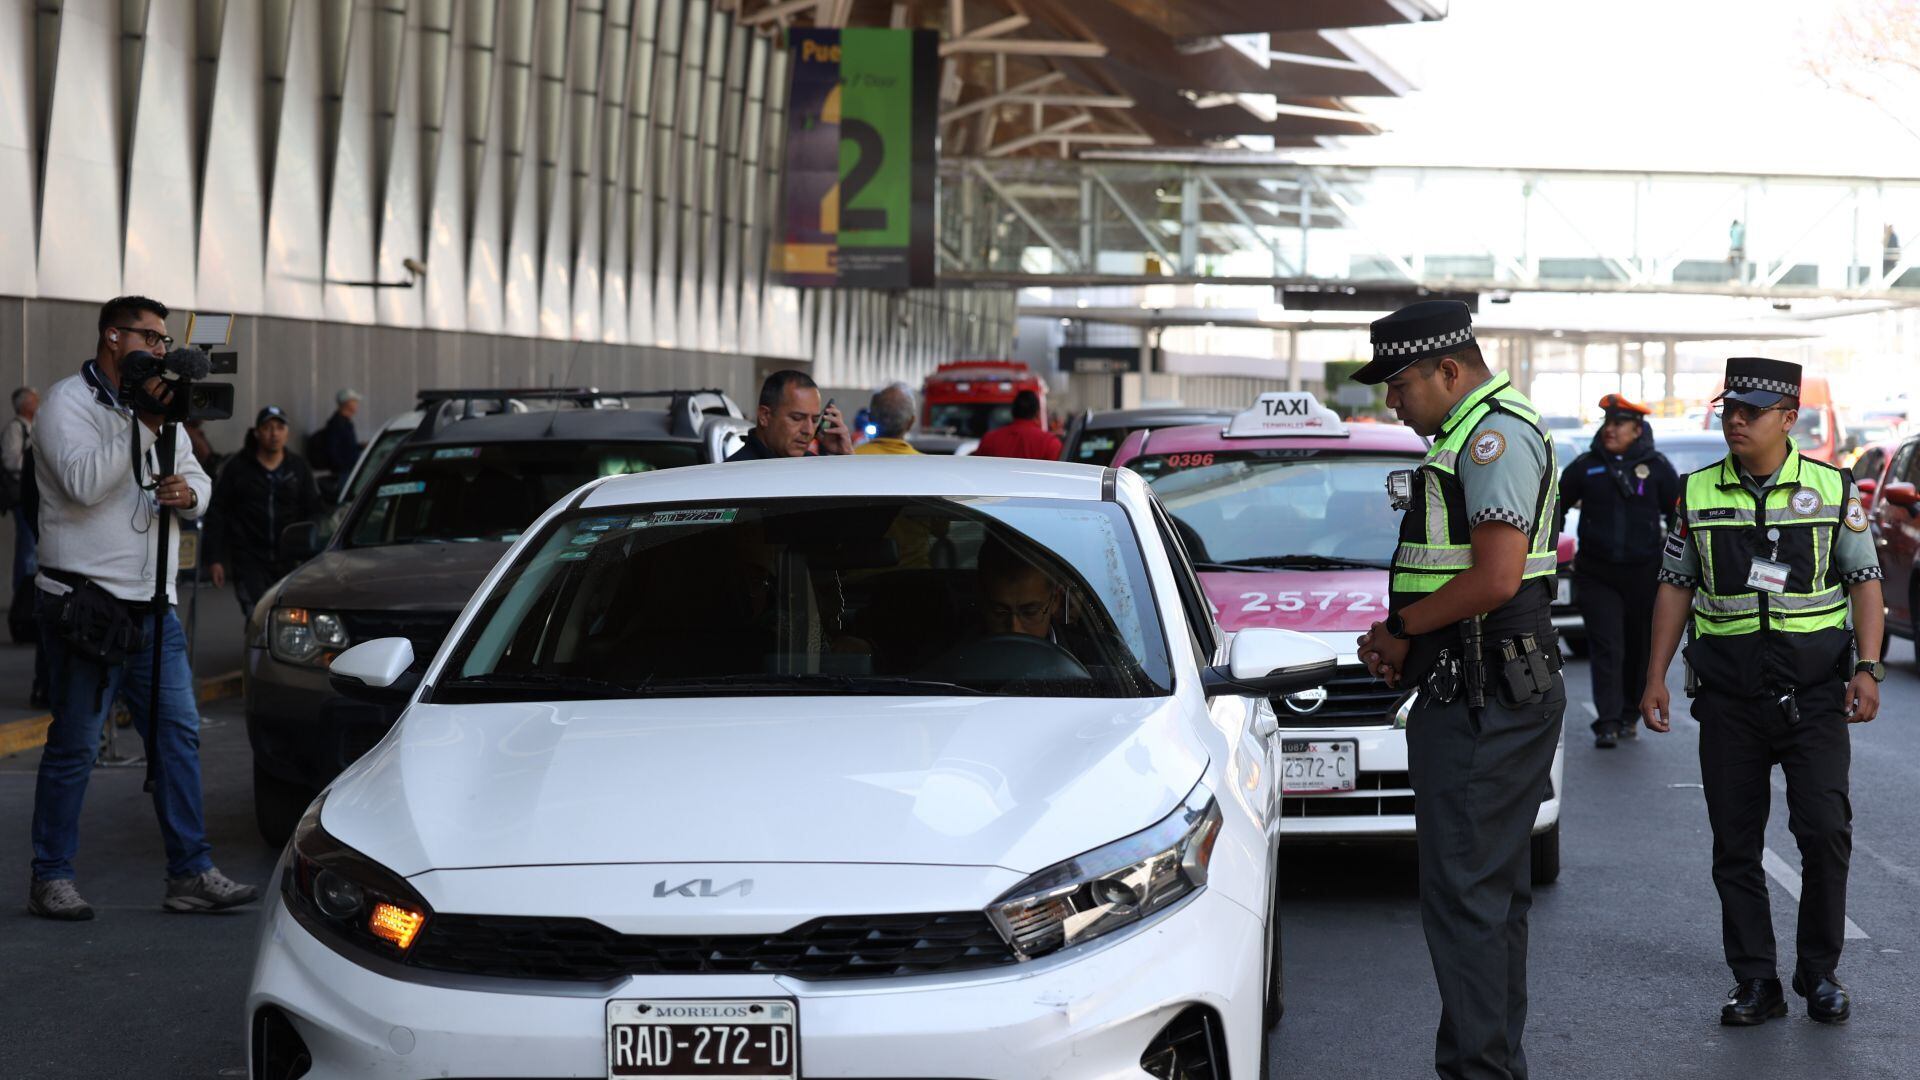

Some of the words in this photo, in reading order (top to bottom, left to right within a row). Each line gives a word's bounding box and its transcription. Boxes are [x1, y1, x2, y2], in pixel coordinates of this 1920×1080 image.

[820, 90, 887, 233] 2
[1262, 399, 1308, 416] TAXI
[1168, 454, 1214, 467] 0396
[1285, 757, 1346, 777] 2572-C
[653, 879, 754, 897] KIA
[656, 1007, 748, 1018] MORELOS
[615, 1026, 789, 1067] RAD-272-D
